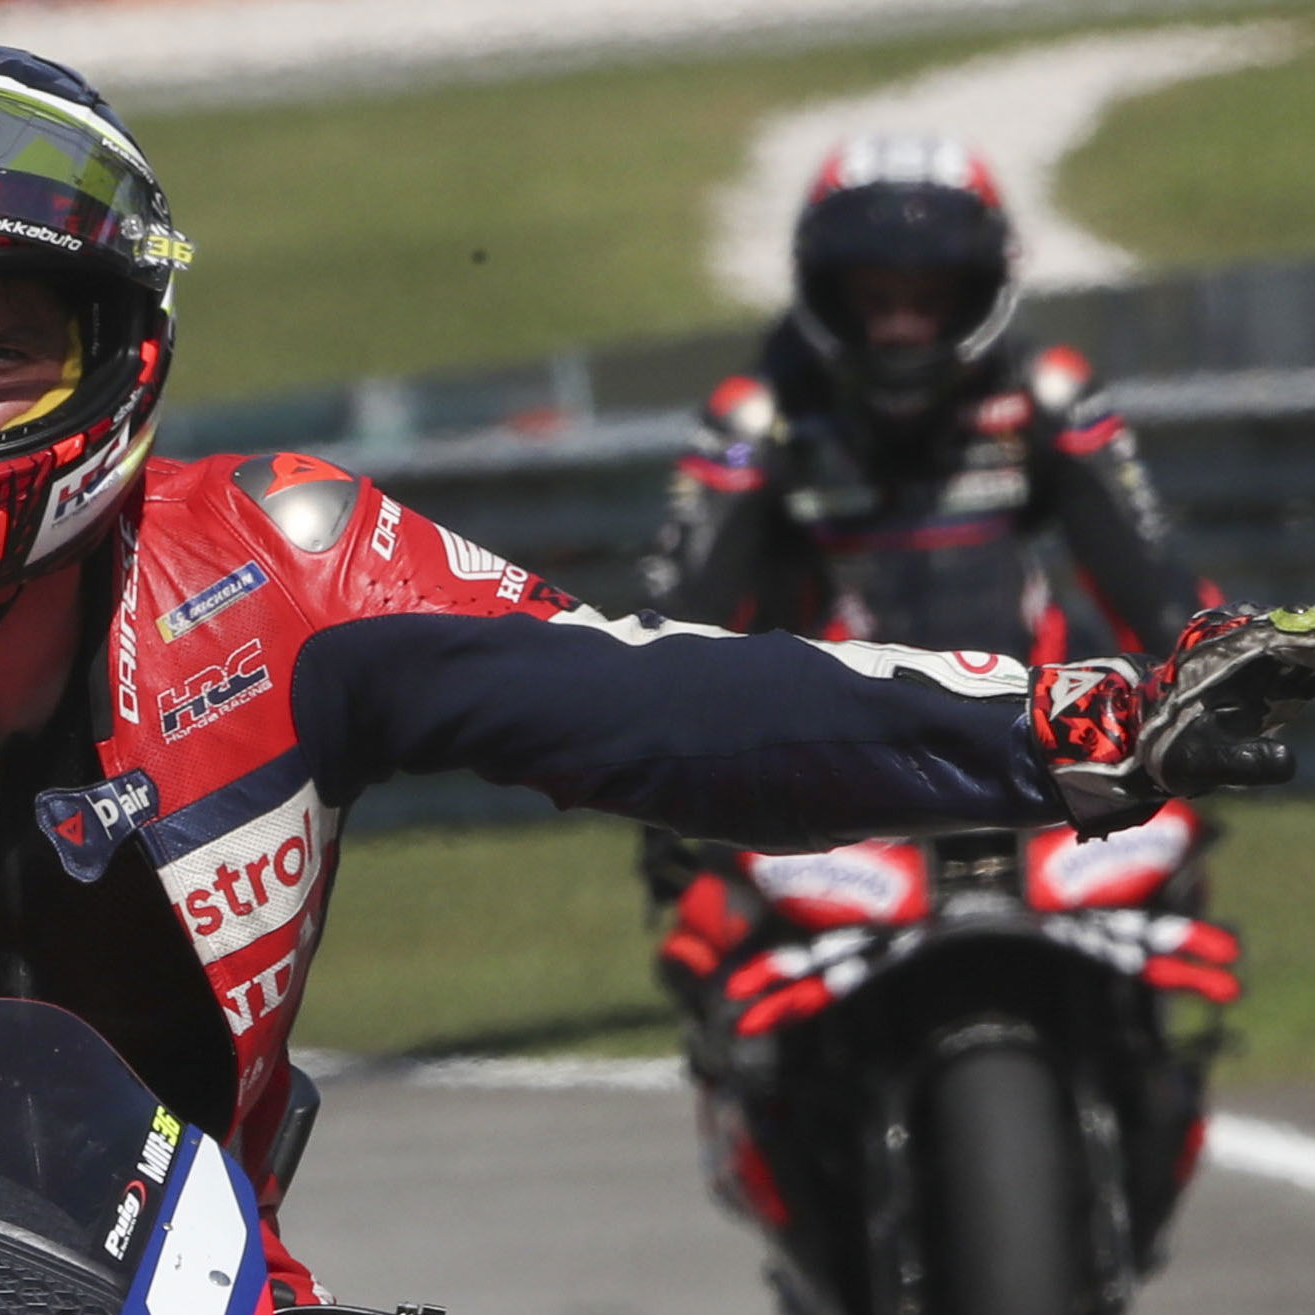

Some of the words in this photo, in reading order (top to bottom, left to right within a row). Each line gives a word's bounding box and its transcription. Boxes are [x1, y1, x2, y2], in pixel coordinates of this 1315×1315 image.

[147, 235, 195, 263] 36
[189, 572, 255, 620] MICHELIN
[157, 638, 269, 736] HRC
[219, 680, 274, 716] RACING
[186, 808, 313, 936] strol
[104, 1192, 141, 1258] Puig
